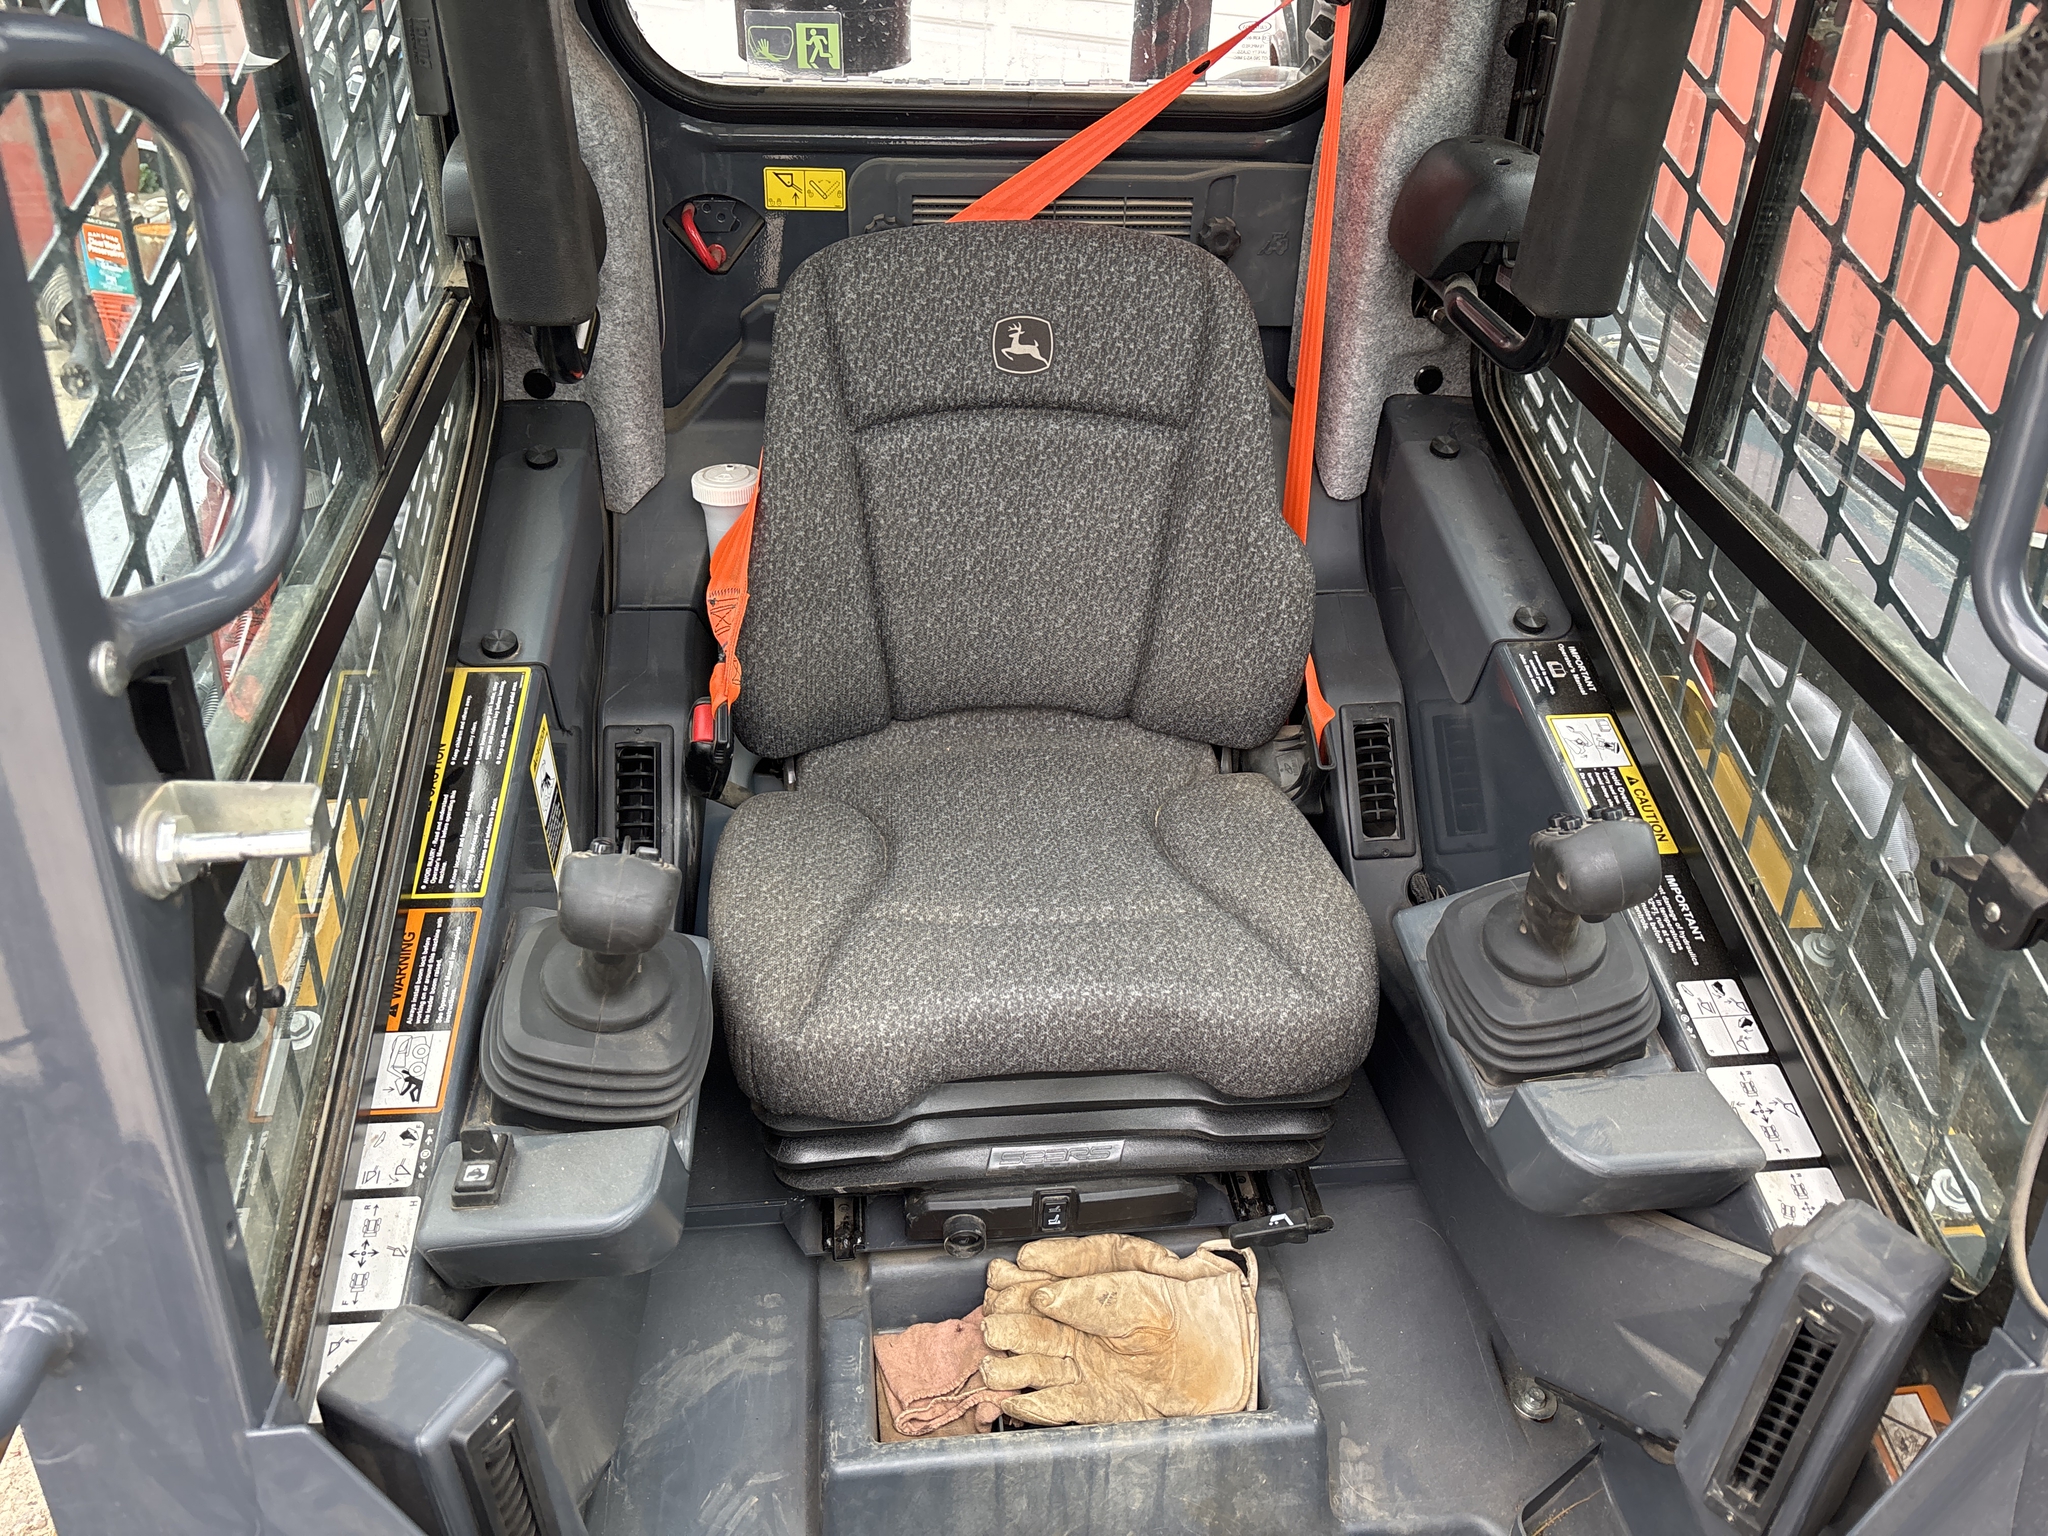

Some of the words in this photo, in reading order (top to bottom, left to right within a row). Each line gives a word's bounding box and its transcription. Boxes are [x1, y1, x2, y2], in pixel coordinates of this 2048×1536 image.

[1558, 644, 1575, 673] Operator's
[1573, 674, 1587, 695] Manual
[1568, 646, 1597, 691] IMPORTANT
[1602, 772, 1610, 784] Carry
[1608, 768, 1622, 785] Avoid
[1618, 787, 1635, 815] Overturn
[460, 817, 470, 837] function
[1633, 788, 1669, 842] CAUTION
[423, 868, 431, 884] AVOID
[427, 848, 436, 866] INJURY
[432, 832, 440, 844] Read
[439, 794, 449, 821] understand
[430, 858, 441, 884] Operator's
[436, 839, 445, 857] Manual
[441, 823, 449, 838] before
[446, 800, 455, 822] operating
[475, 870, 483, 883] Keep
[479, 849, 487, 868] screens
[485, 817, 494, 838] windows
[453, 847, 463, 868] location
[450, 869, 458, 883] Know
[463, 870, 471, 883] Keep
[1634, 906, 1648, 931] ontrols.
[1665, 874, 1706, 942] IMPORTANT
[1650, 922, 1663, 943] before
[1656, 917, 1664, 928] run
[1665, 938, 1676, 953] slow
[1659, 907, 1683, 950] temperatures
[1662, 896, 1677, 921] damage
[1679, 931, 1699, 965] hydraulics
[422, 937, 431, 954] before
[392, 931, 415, 999] WARNING
[415, 968, 424, 984] boom
[416, 1001, 426, 1024] working
[421, 992, 426, 1000] on
[425, 964, 433, 984] around
[432, 929, 440, 952] machine
[419, 956, 427, 967] lock
[438, 982, 450, 1011] Operator's
[445, 961, 454, 980] Manual
[452, 926, 461, 951] complete
[411, 985, 420, 1002] install
[429, 978, 438, 994] boom
[406, 1004, 416, 1024] Always
[425, 995, 434, 1013] loader
